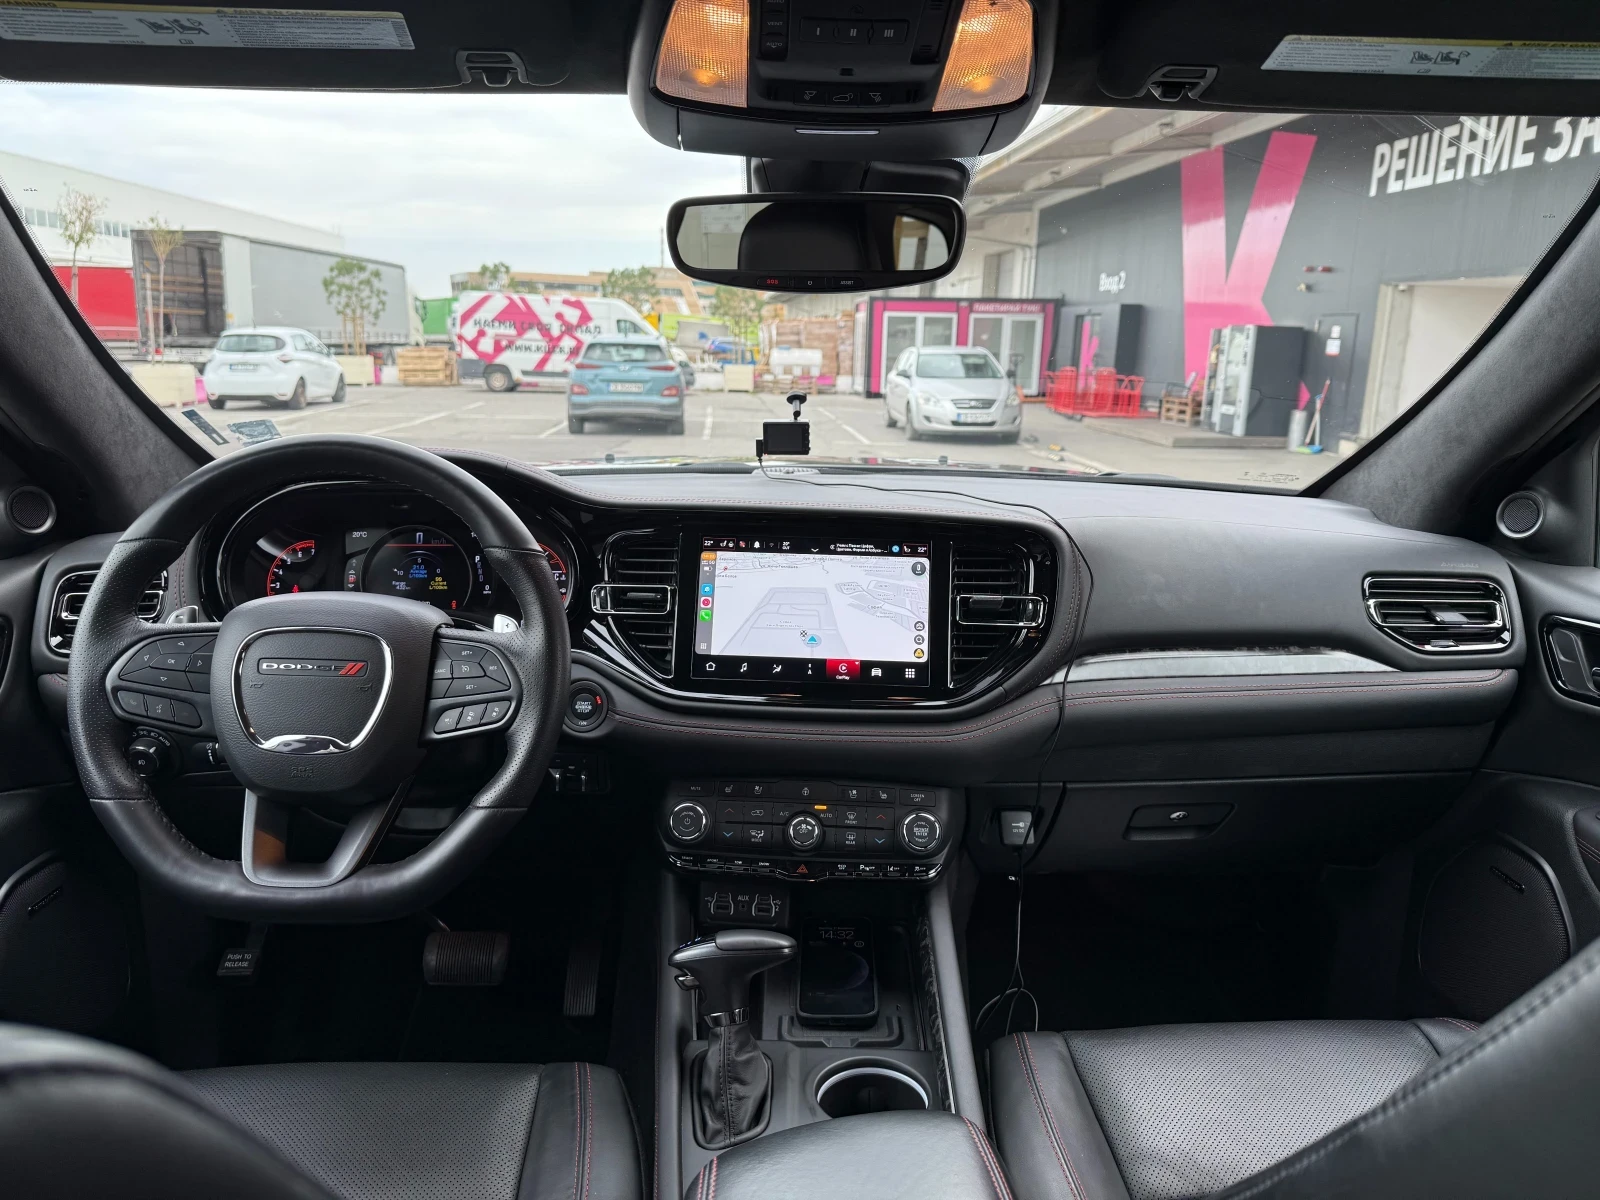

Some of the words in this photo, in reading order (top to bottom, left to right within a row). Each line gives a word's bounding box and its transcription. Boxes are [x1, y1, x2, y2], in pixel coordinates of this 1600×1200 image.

[1368, 114, 1538, 198] РЕШЕНИЕ
[262, 662, 344, 672] DODGE
[158, 735, 171, 747] AUTO
[819, 930, 855, 940] 14:32
